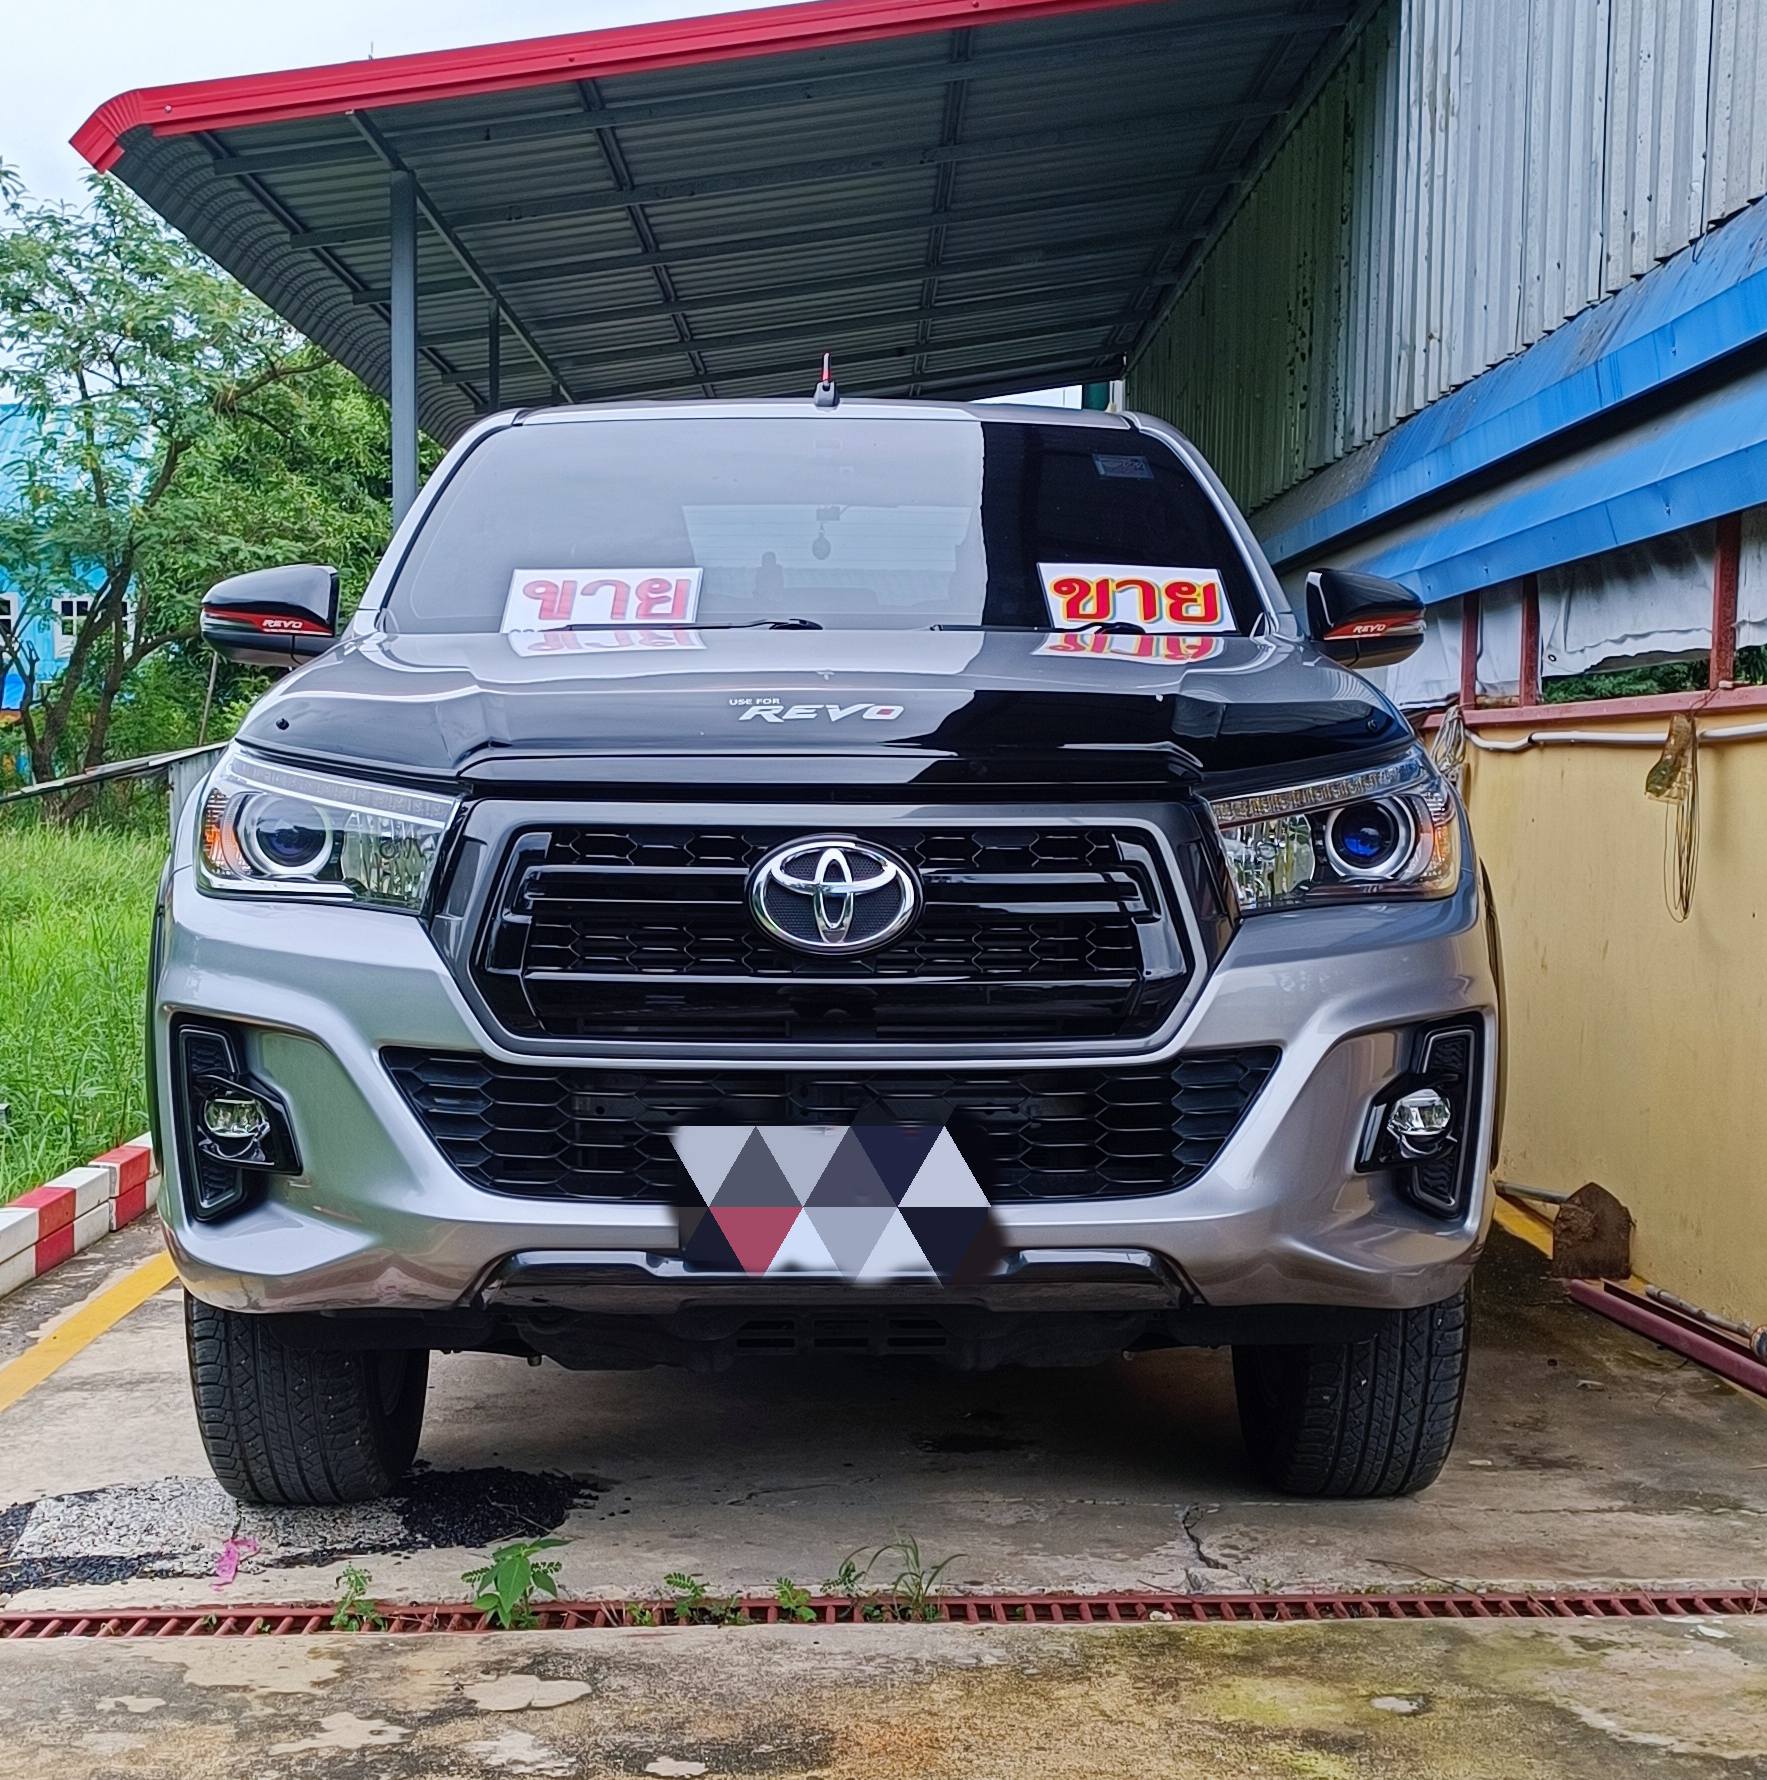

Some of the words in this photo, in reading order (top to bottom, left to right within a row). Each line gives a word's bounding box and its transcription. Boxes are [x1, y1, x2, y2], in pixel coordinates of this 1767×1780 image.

[522, 577, 692, 620] ขาย
[1051, 576, 1222, 624] ขาย
[262, 619, 303, 629] REVO
[1352, 623, 1386, 633] REVO
[738, 703, 905, 723] REVO
